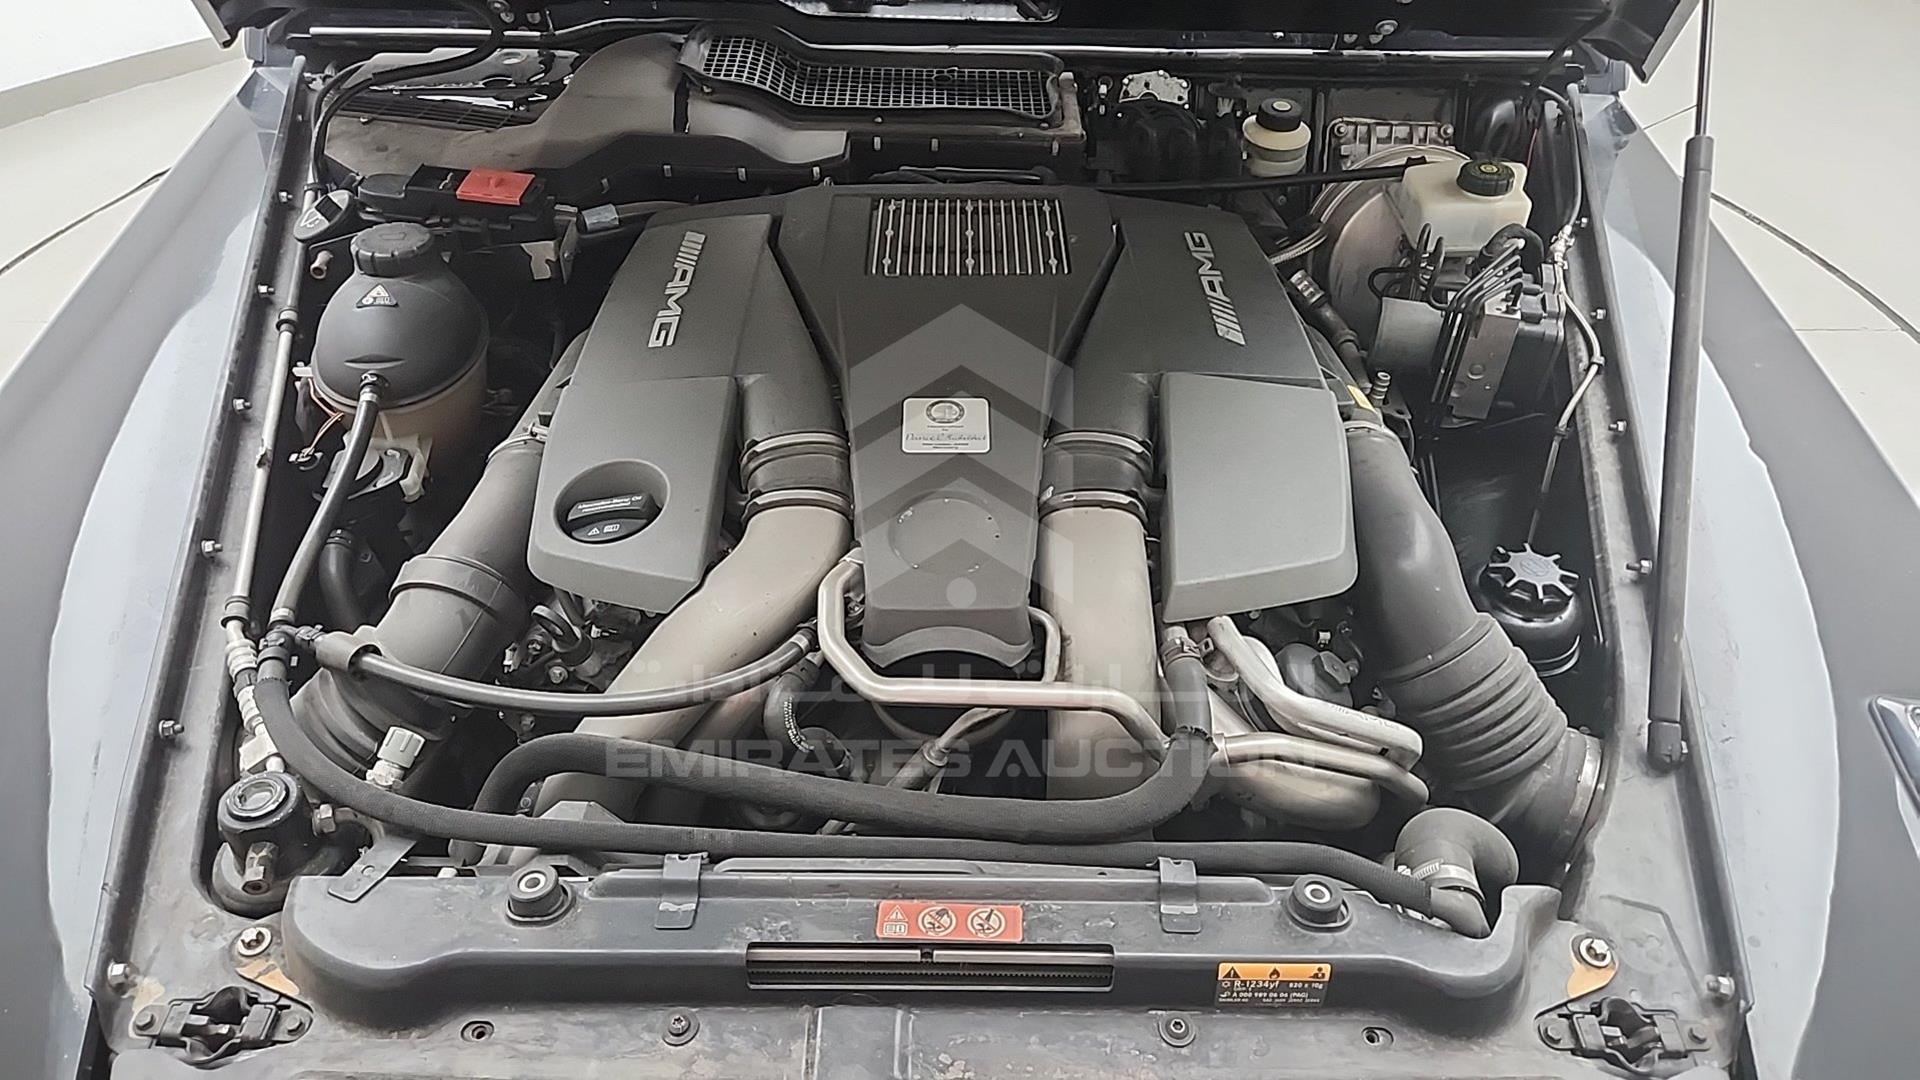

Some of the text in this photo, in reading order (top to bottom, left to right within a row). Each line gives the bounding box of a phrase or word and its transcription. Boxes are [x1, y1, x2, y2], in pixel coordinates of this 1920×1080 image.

[647, 257, 697, 348] AMG
[1184, 231, 1234, 308] AMG
[1233, 980, 1279, 989] R-1234yf
